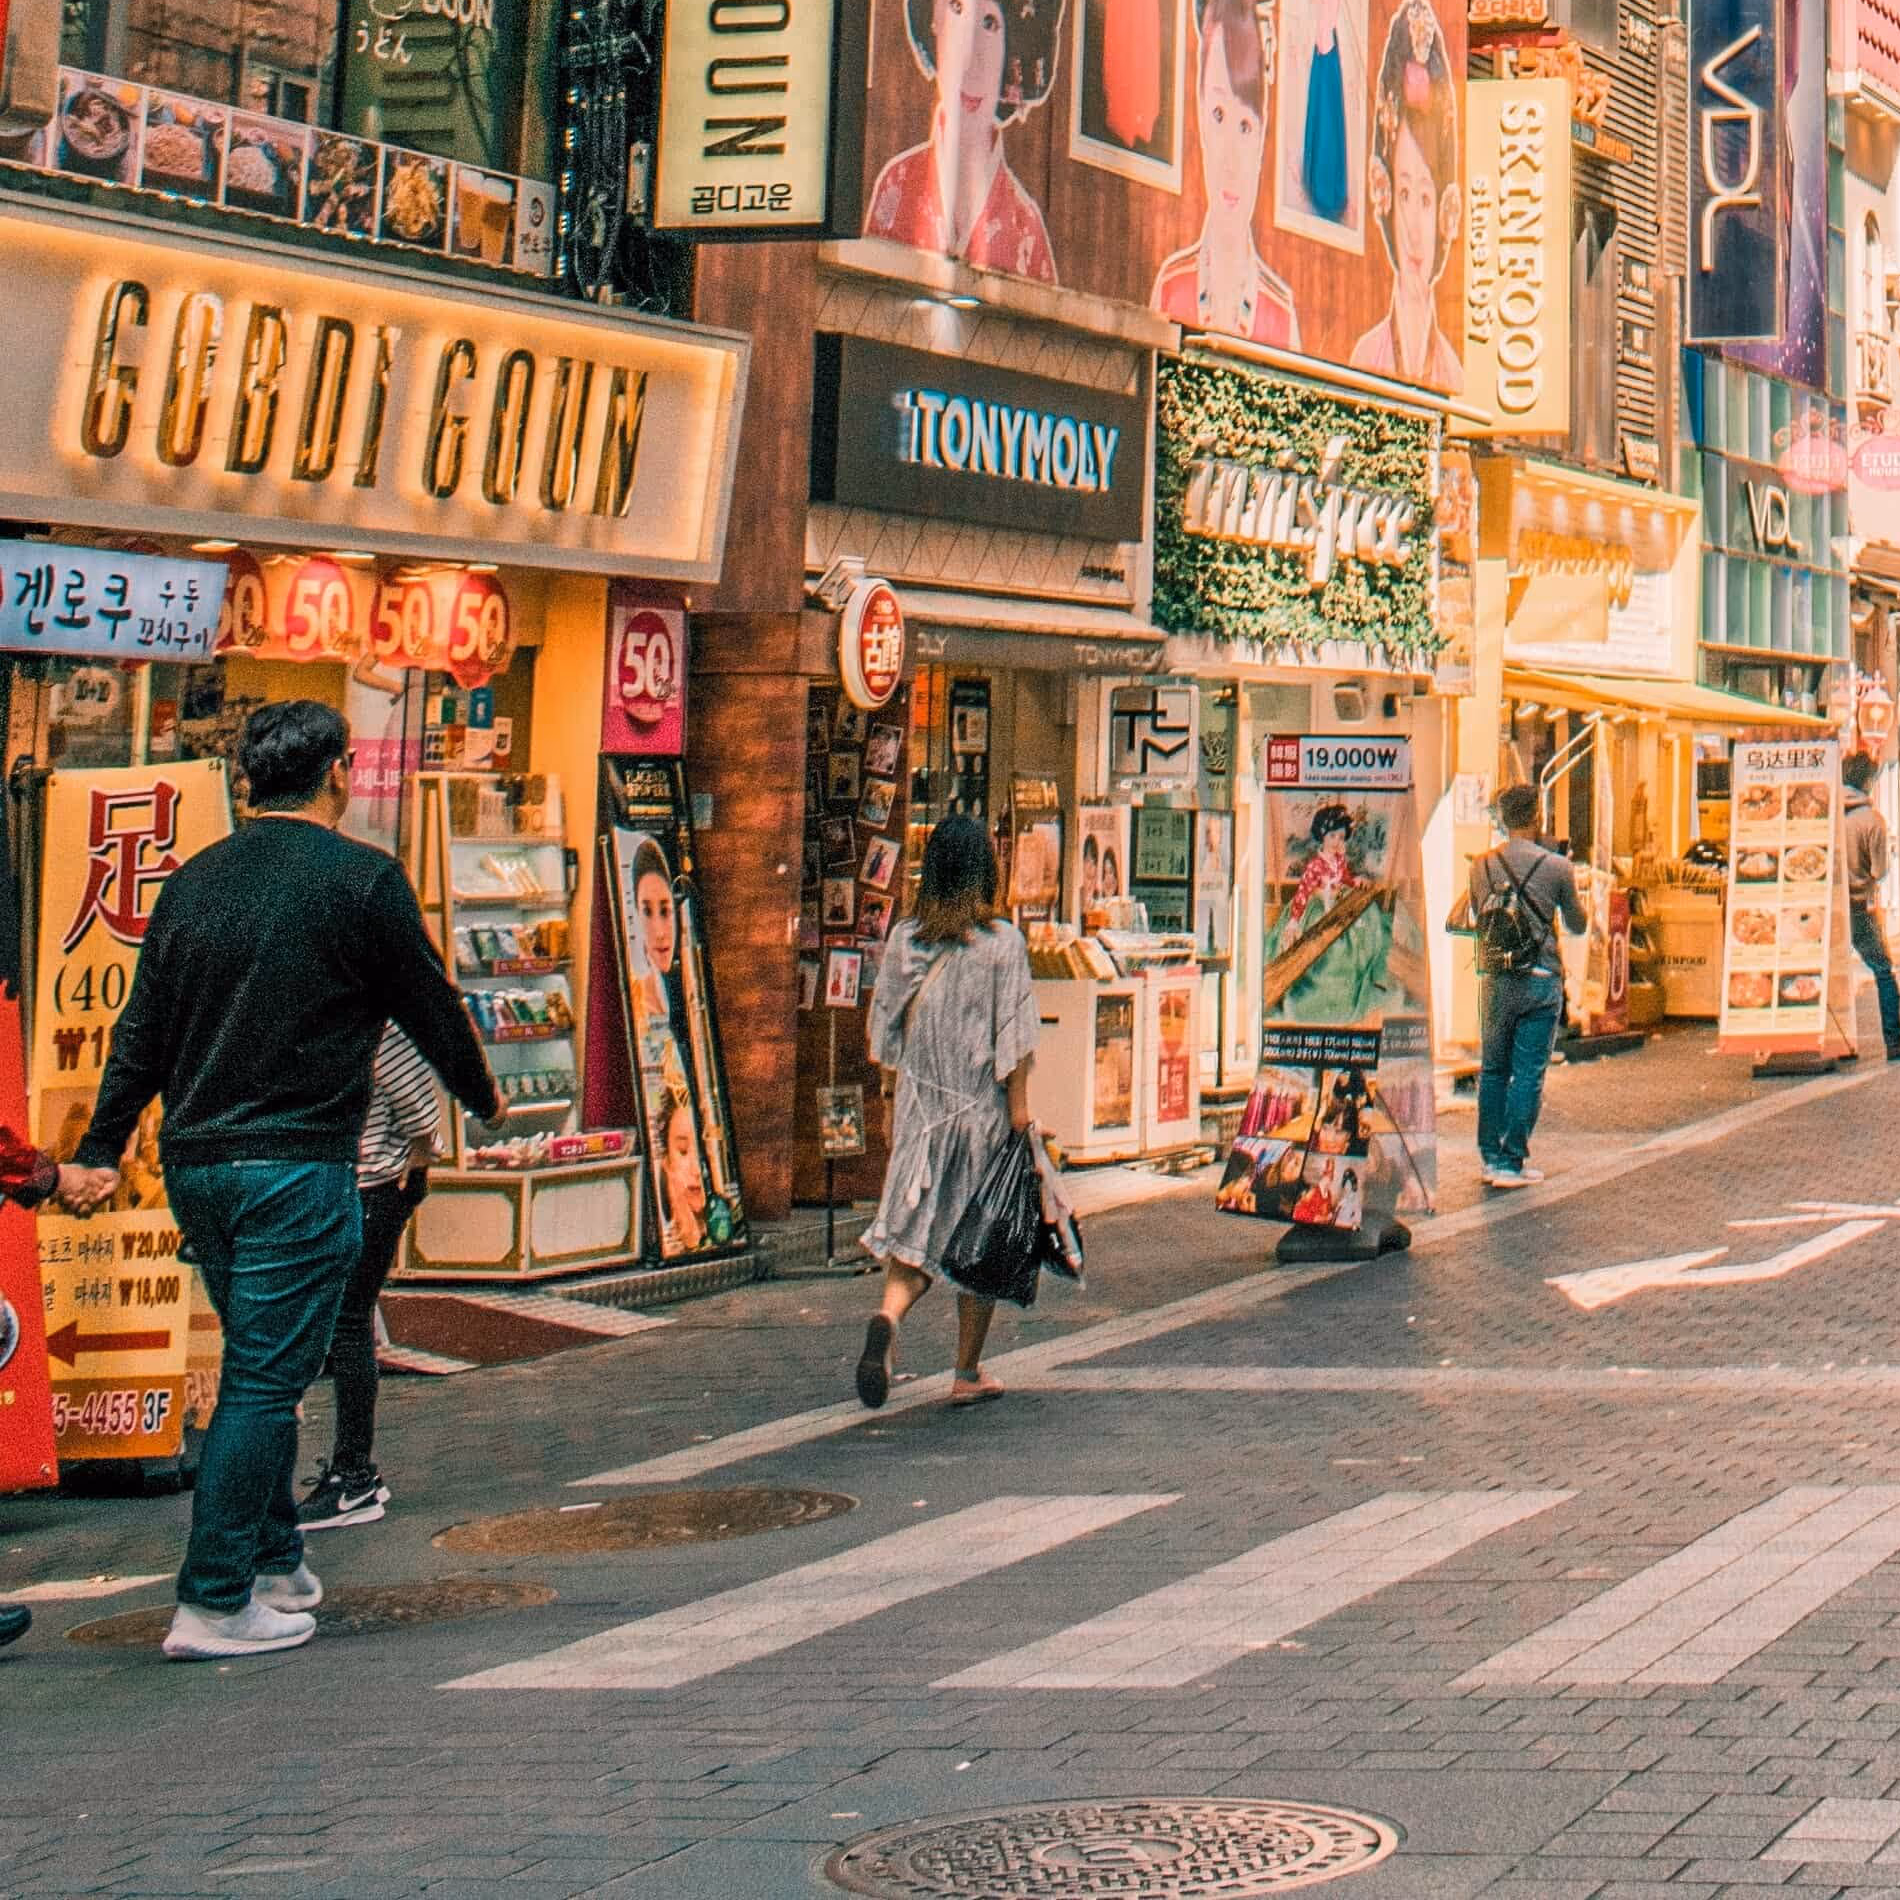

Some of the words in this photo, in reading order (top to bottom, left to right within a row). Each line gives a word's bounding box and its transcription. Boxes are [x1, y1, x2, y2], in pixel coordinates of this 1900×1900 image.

[1702, 24, 1761, 272] VDL
[690, 183, 793, 213] 곱디고운
[1498, 100, 1545, 414] SKINFOOD
[80, 280, 402, 490] GOBDI
[421, 337, 648, 517] GOUN
[908, 389, 1121, 492] TONYMOLY
[1746, 481, 1802, 551] VDL
[14, 563, 134, 641] 겐로쿠
[621, 631, 671, 699] 50
[62, 780, 184, 955] 足
[118, 1274, 181, 1307] ₩18,000
[142, 1390, 171, 1434] 3F
